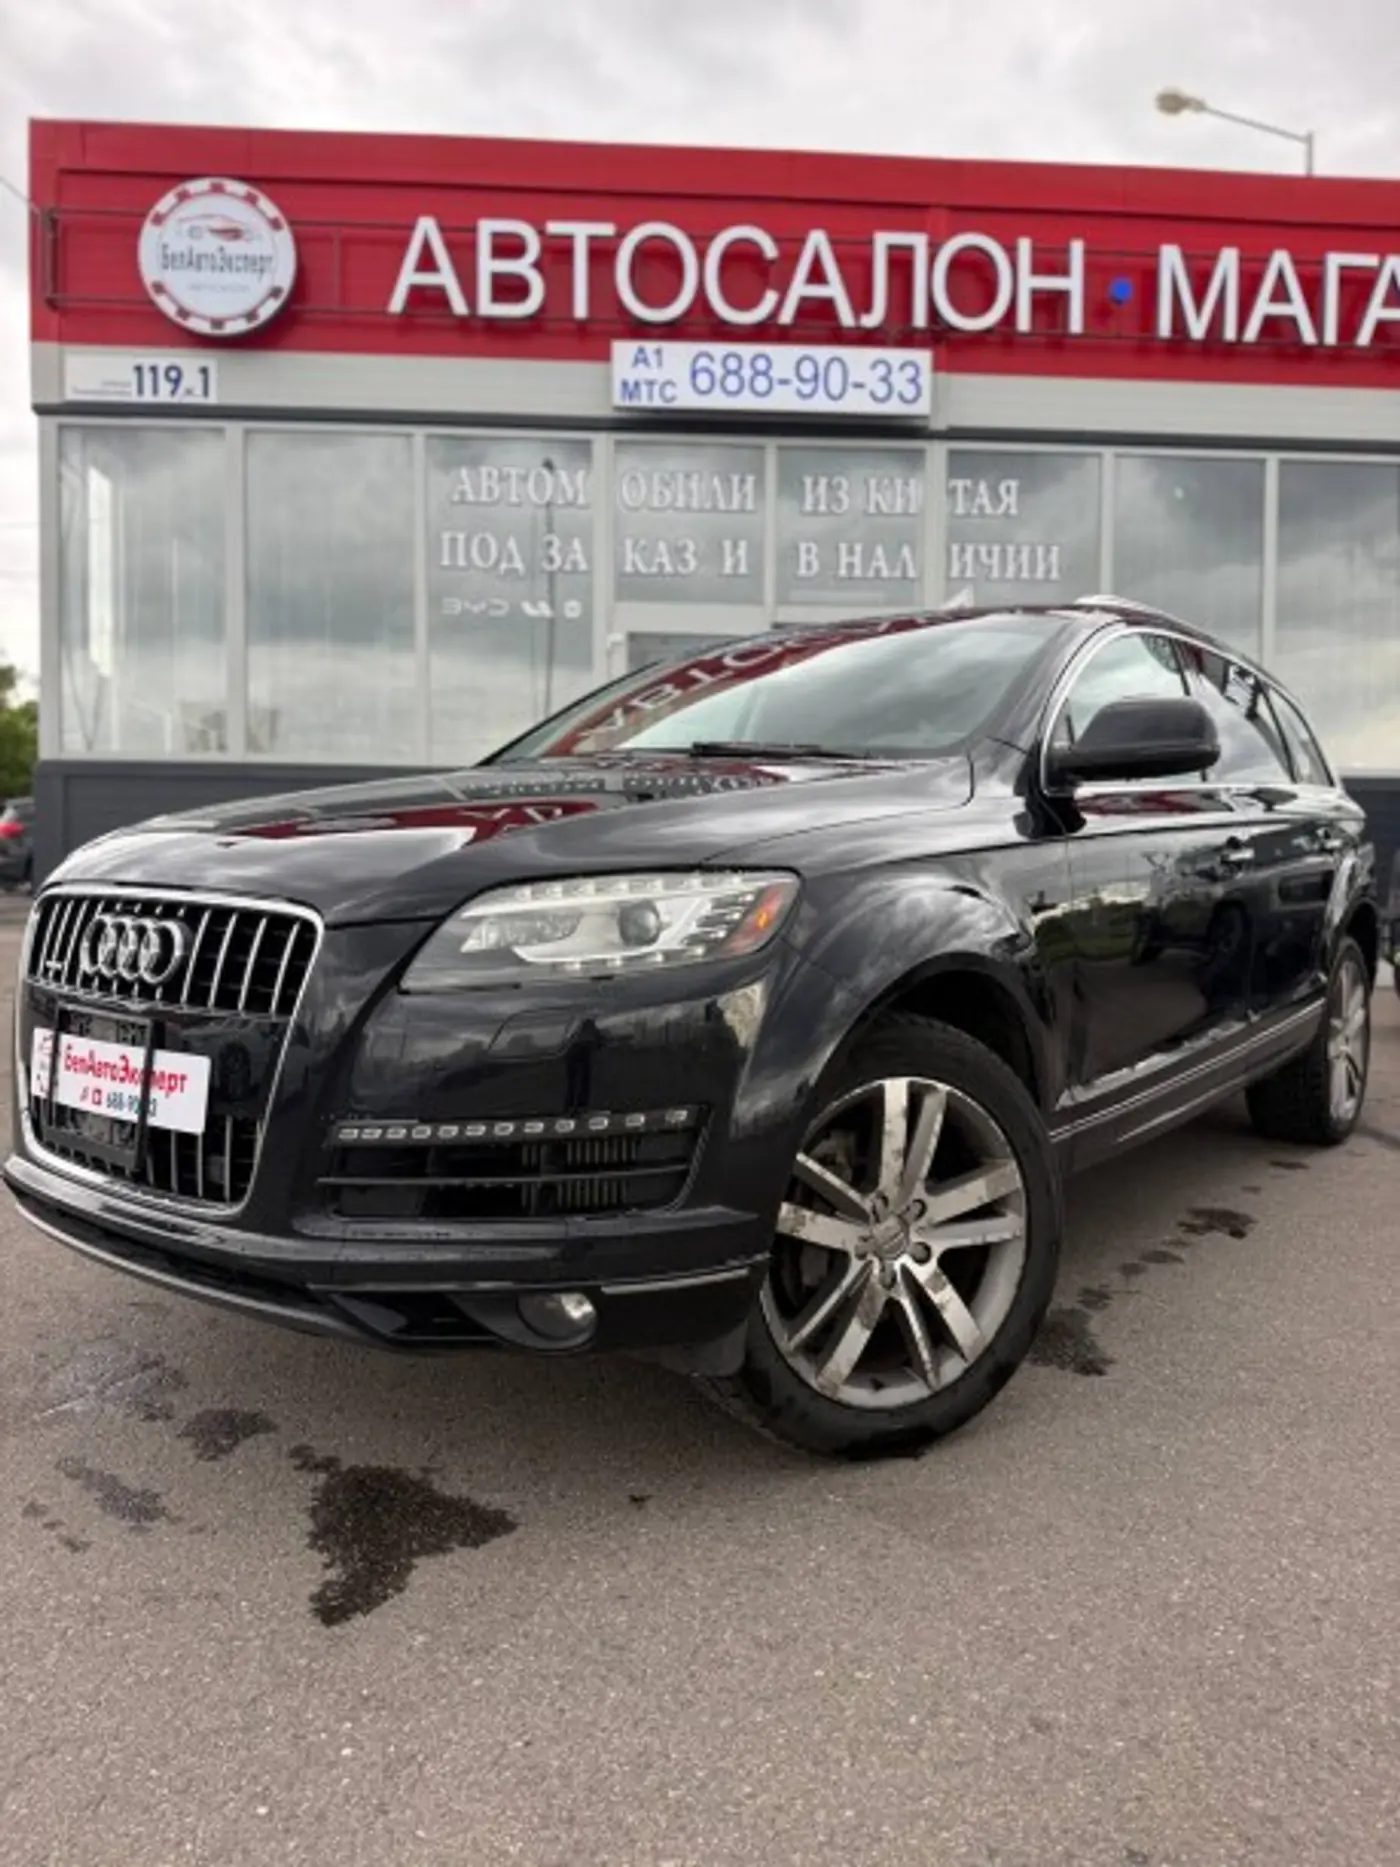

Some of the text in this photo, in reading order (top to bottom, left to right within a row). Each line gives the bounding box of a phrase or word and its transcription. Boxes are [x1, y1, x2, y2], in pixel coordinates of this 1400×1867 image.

[386, 215, 1084, 335] АВТОСАЛОН
[690, 351, 922, 405] 688-90-33
[802, 475, 850, 514] ИЗ
[439, 531, 526, 576] ПОД
[722, 539, 749, 575] И
[797, 541, 820, 578] В
